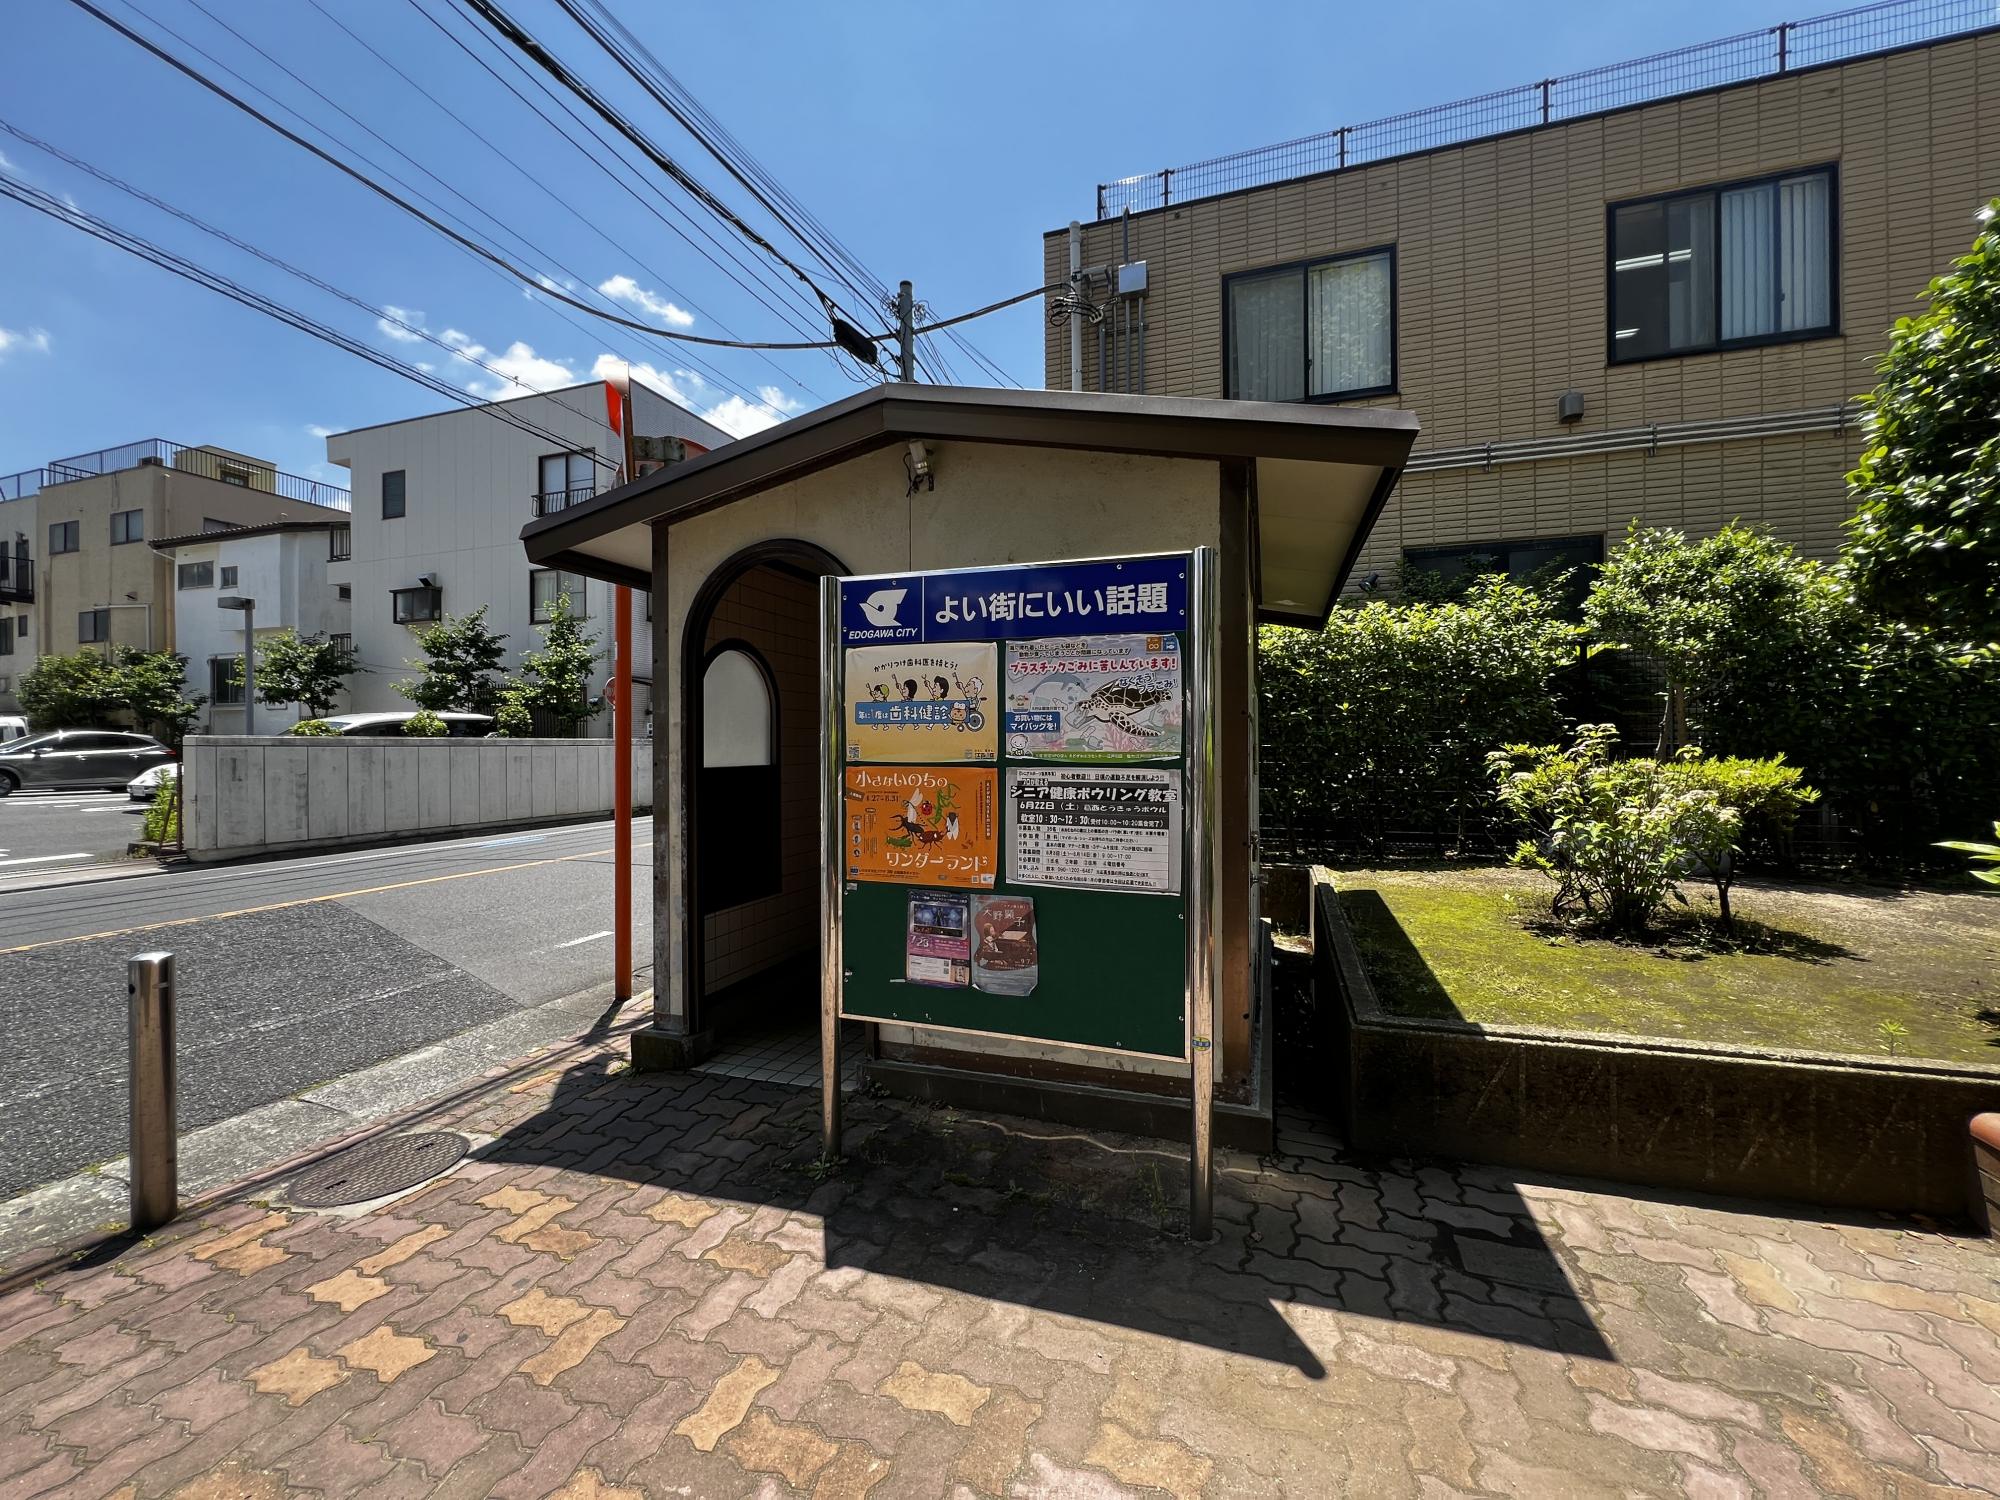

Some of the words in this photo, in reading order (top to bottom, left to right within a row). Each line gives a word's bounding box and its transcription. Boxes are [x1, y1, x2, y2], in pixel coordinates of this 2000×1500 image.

[935, 582, 1169, 623] よい街にいい話題
[848, 628, 895, 640] EDOGAWA
[896, 627, 918, 639] CITY
[1010, 656, 1178, 675] プラスチックごみに苦しんでいます!
[1010, 722, 1057, 731] マイバッグを!
[1014, 714, 1053, 722] お買い物には
[855, 770, 948, 788] 小さないのちの
[1010, 785, 1178, 803] シニア健康ボウリング教室
[885, 852, 988, 872] ワンダーランド
